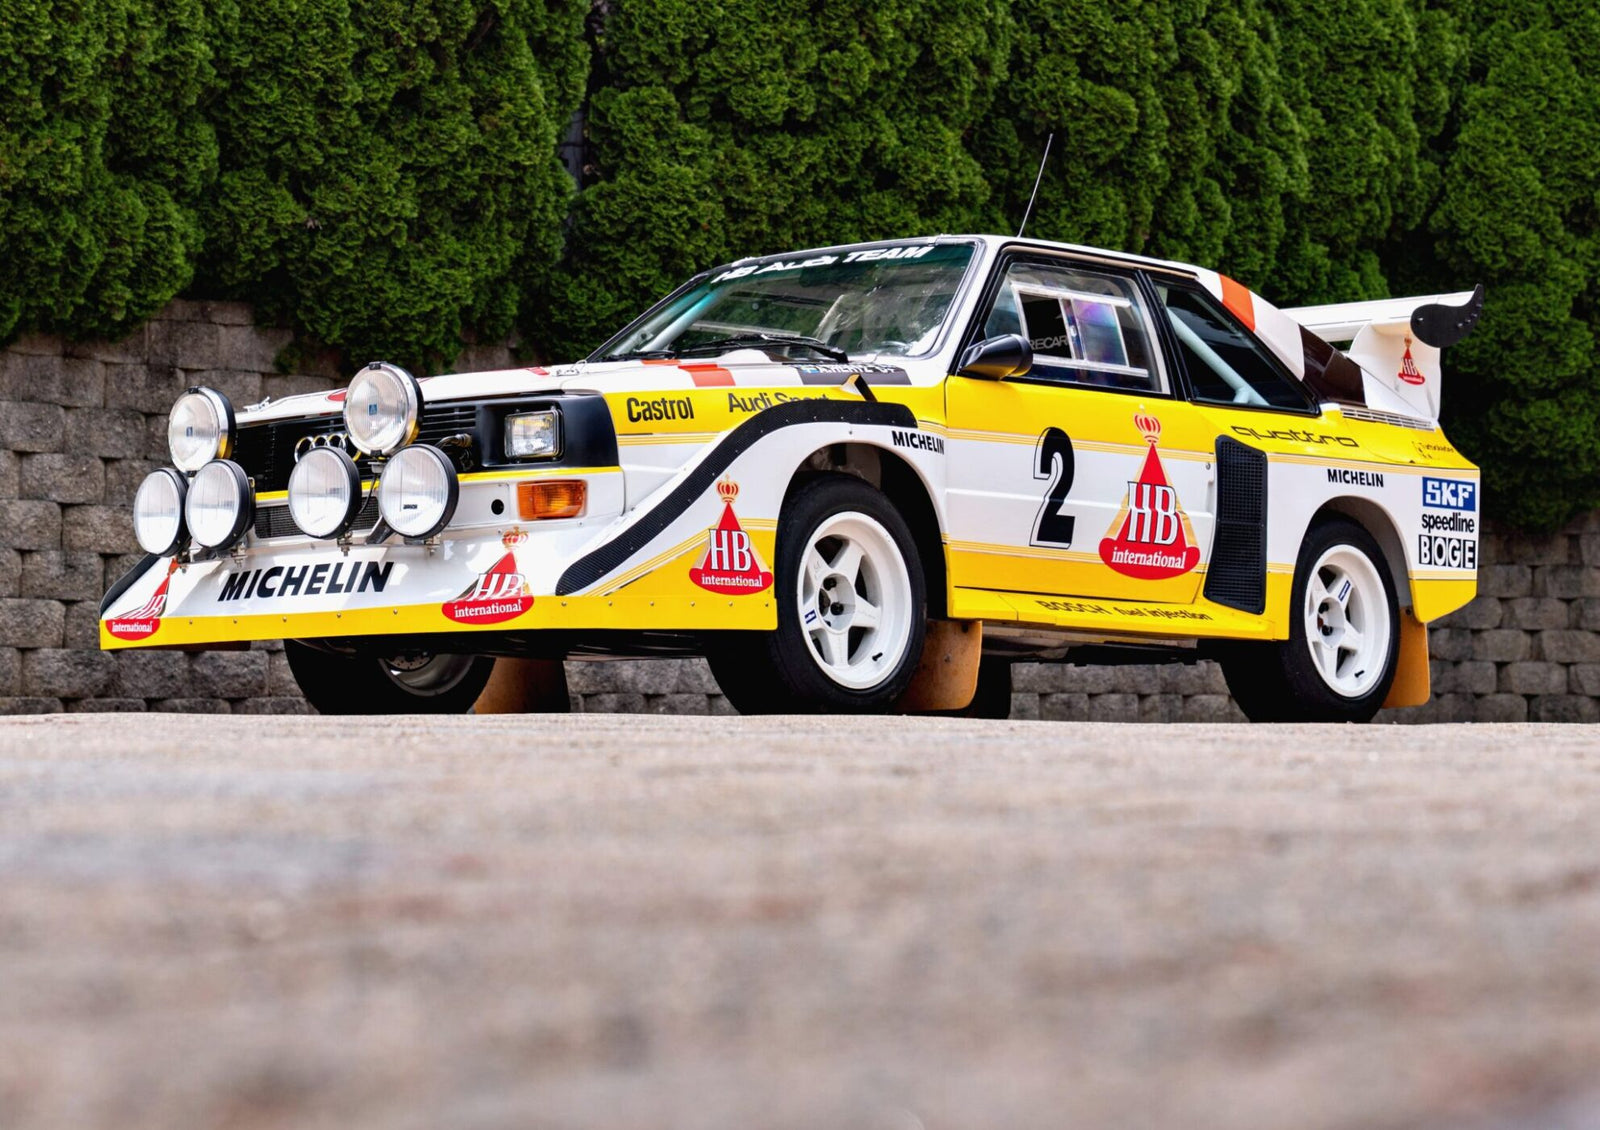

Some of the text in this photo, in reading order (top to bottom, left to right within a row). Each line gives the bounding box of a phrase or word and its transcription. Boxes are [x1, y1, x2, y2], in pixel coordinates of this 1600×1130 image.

[843, 246, 935, 263] TEAM
[1030, 335, 1068, 350] RECAR
[627, 397, 694, 423] Castrol
[727, 392, 772, 413] Audi
[891, 430, 945, 455] MICHELIN
[1231, 425, 1359, 448] quattro
[1029, 426, 1076, 549] 2
[1327, 468, 1384, 488] MICHELIN
[1425, 480, 1473, 507] SKF
[1127, 481, 1179, 545] HB
[1421, 512, 1475, 534] speedline
[708, 528, 752, 572] HB
[1111, 546, 1187, 569] international
[1419, 534, 1476, 569] BOGE
[217, 561, 395, 602] MICHELIN
[701, 573, 763, 588] international
[454, 598, 523, 618] international
[1035, 600, 1214, 621] BOSCH fuel injection
[112, 621, 154, 633] international
